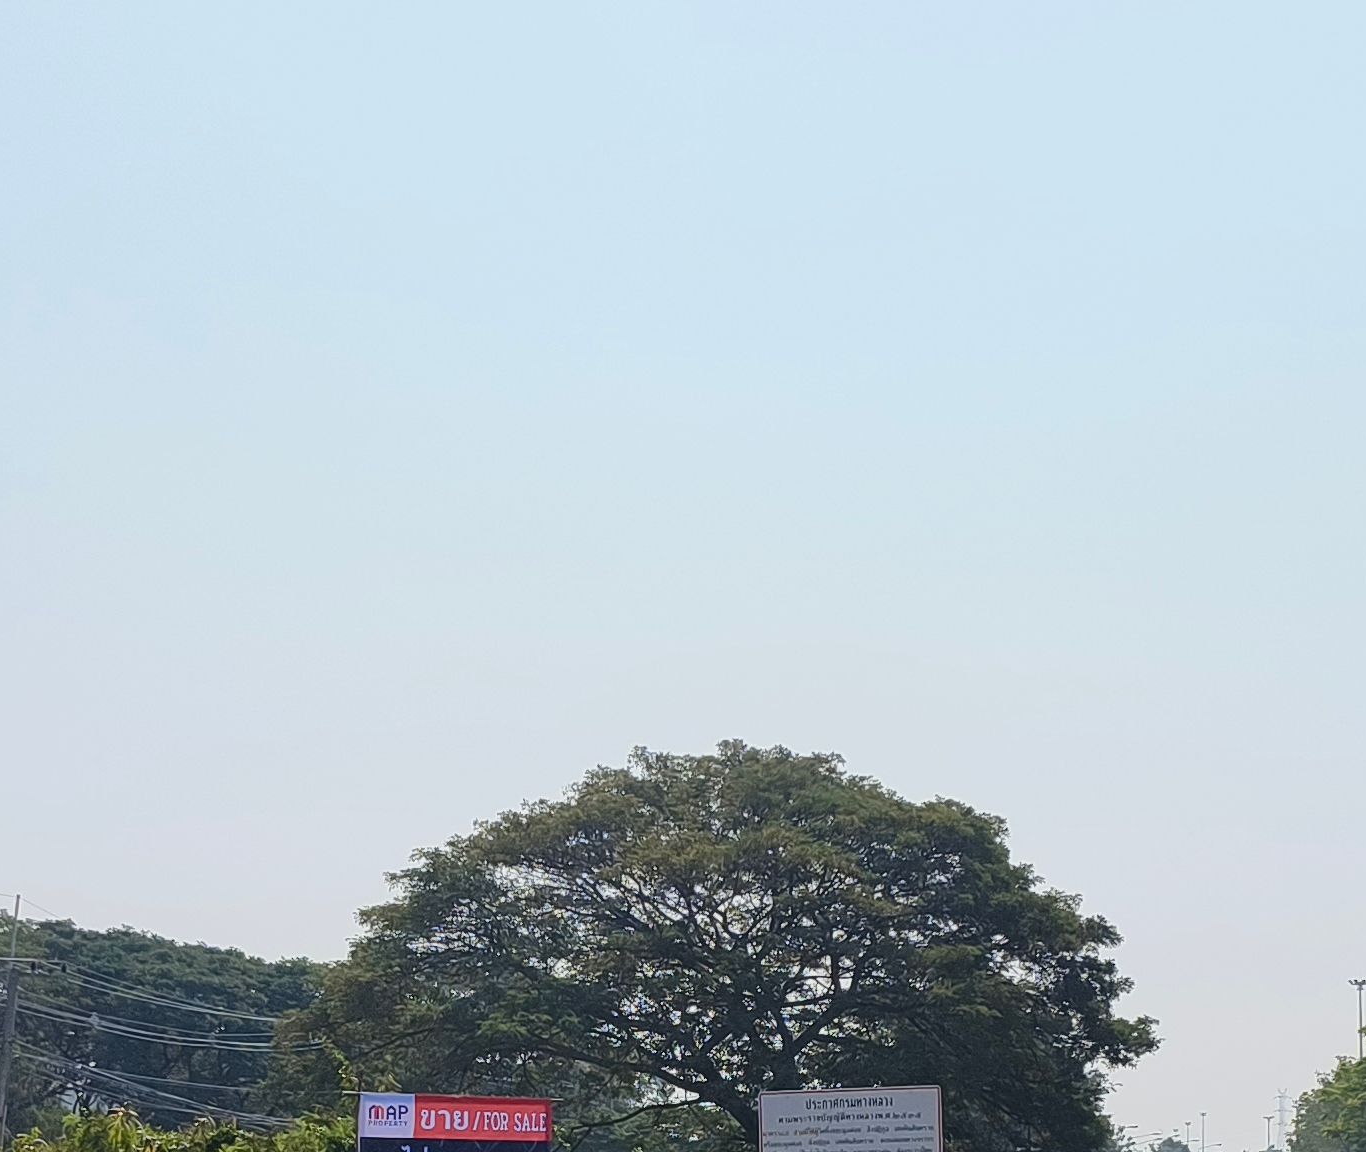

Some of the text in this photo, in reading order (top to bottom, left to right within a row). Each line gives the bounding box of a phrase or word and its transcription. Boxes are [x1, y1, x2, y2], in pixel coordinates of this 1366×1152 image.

[368, 1104, 408, 1120] MAP
[420, 1109, 469, 1131] ขาย
[483, 1112, 509, 1131] FOR
[513, 1112, 547, 1132] SALE
